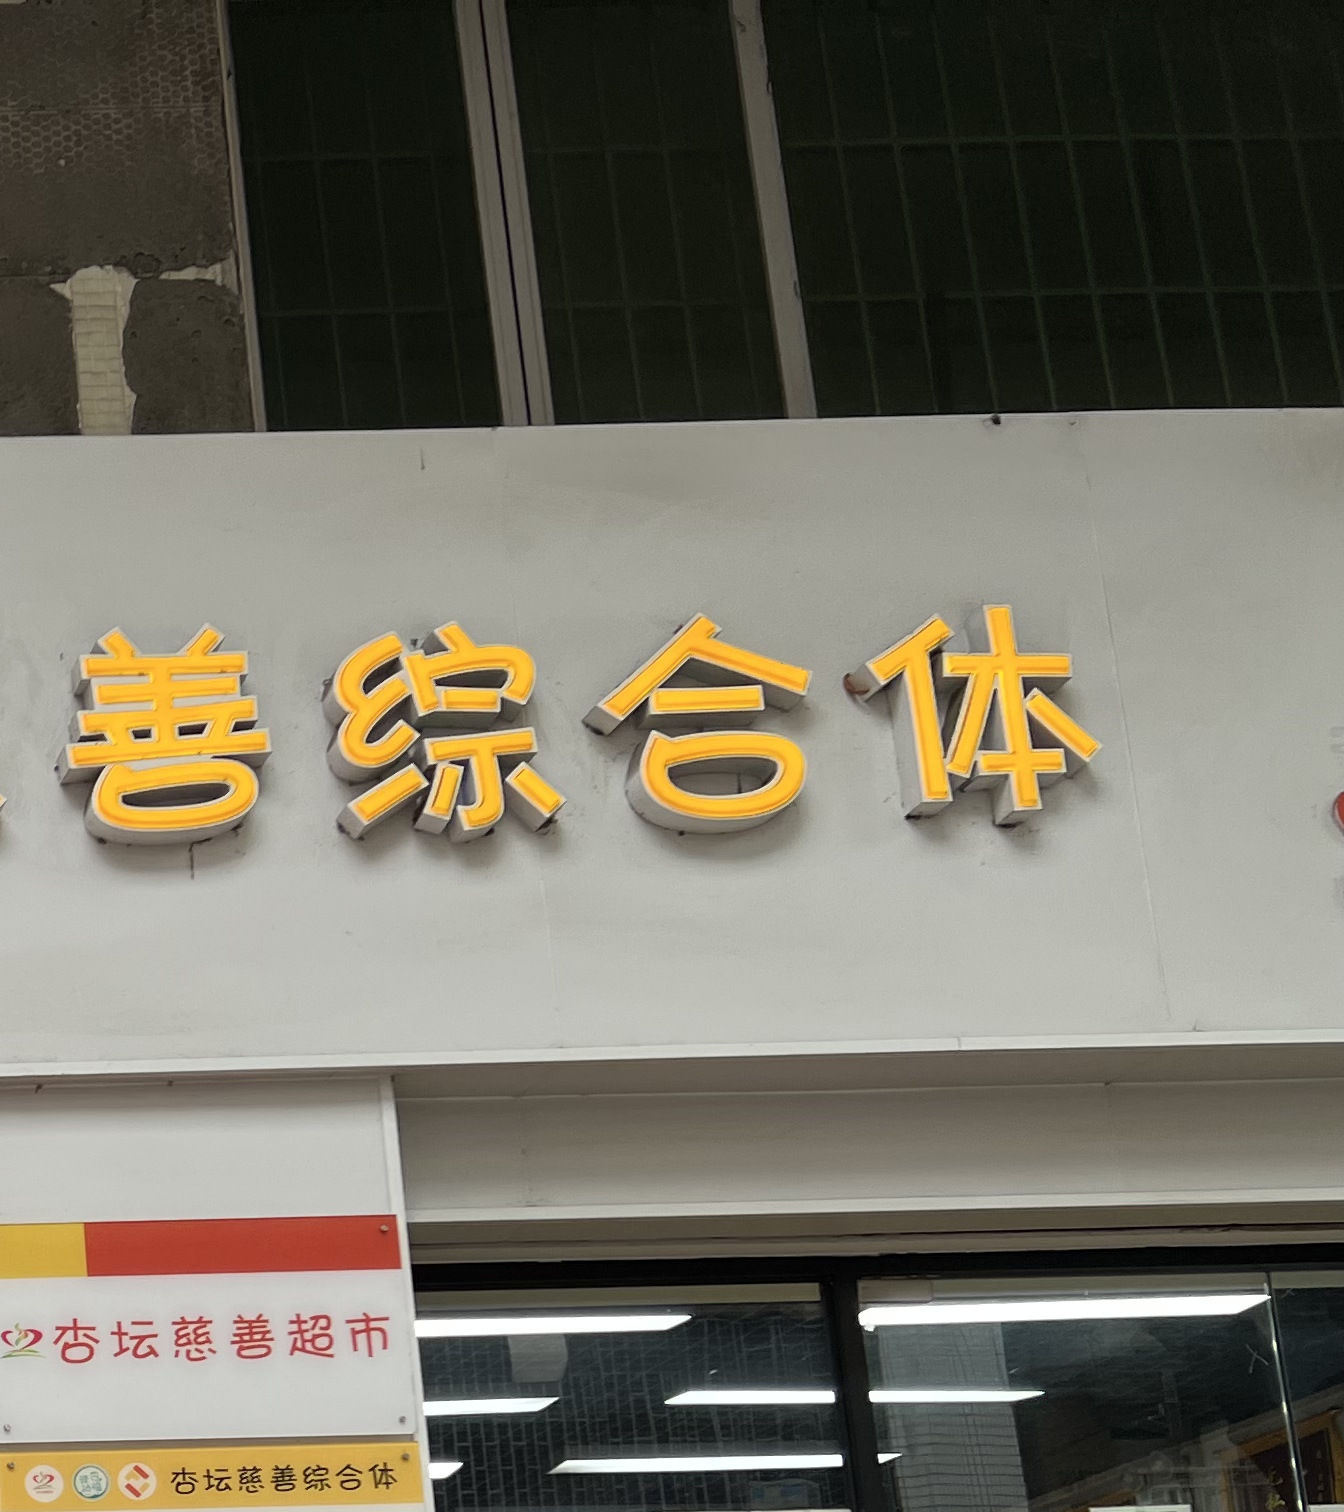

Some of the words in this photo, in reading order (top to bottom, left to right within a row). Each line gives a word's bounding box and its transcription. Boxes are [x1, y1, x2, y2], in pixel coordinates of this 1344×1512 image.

[53, 1313, 390, 1364] 杏坛慈善超市
[170, 1462, 397, 1494] 杏坛慈善综合体
